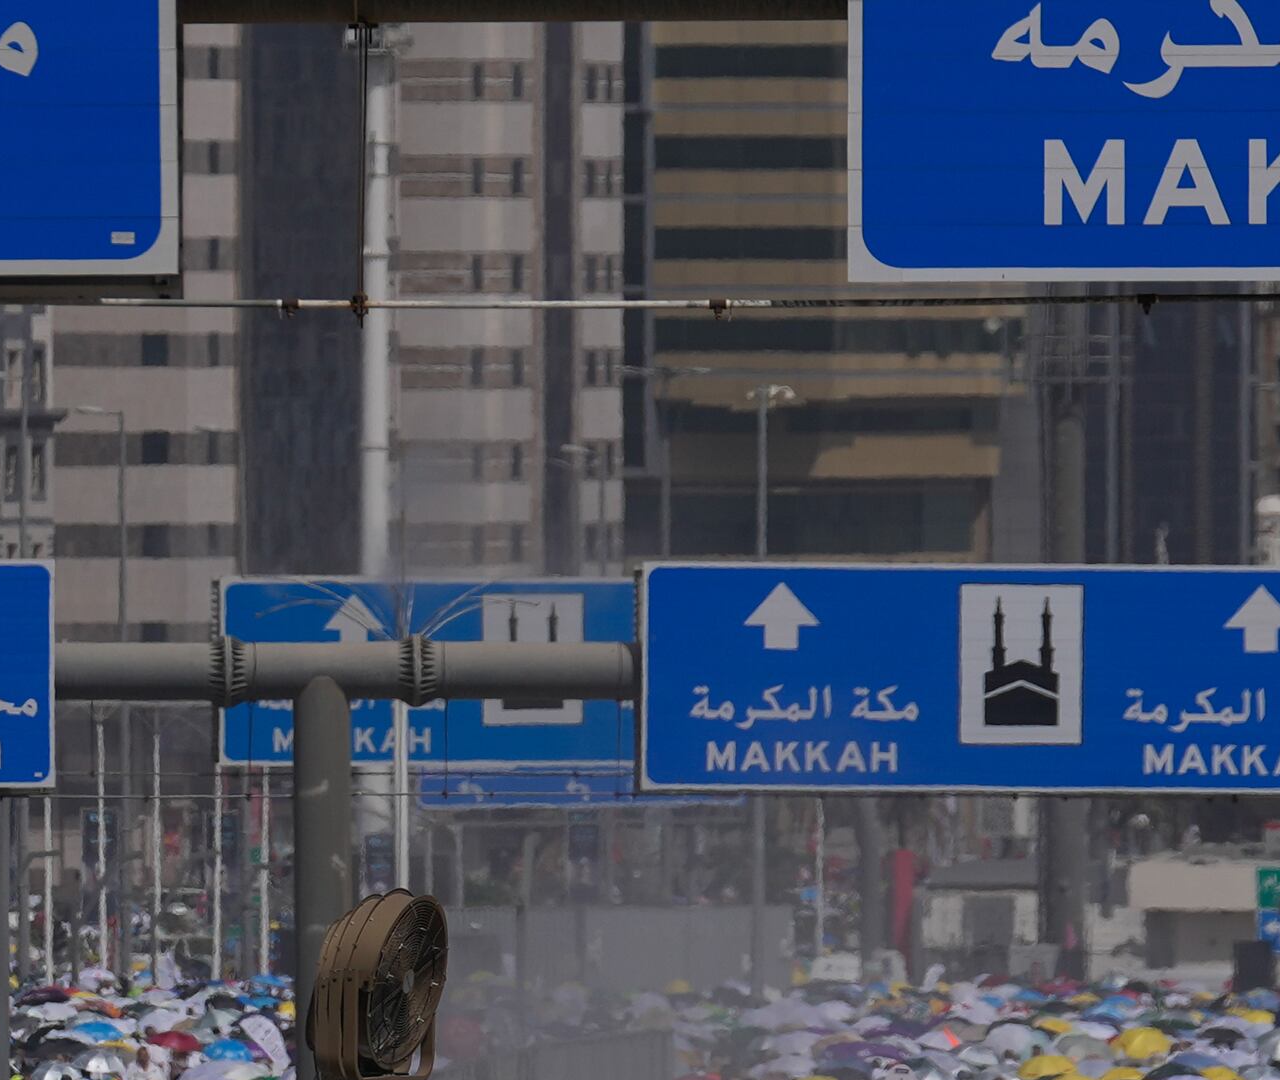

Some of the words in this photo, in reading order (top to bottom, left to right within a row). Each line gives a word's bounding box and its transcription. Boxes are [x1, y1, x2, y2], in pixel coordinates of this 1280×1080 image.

[690, 684, 832, 729] المكرمة
[850, 685, 919, 722] مكة
[1123, 687, 1265, 733] المكرمة
[272, 727, 432, 753] MKAH
[706, 740, 898, 773] MAKKAH
